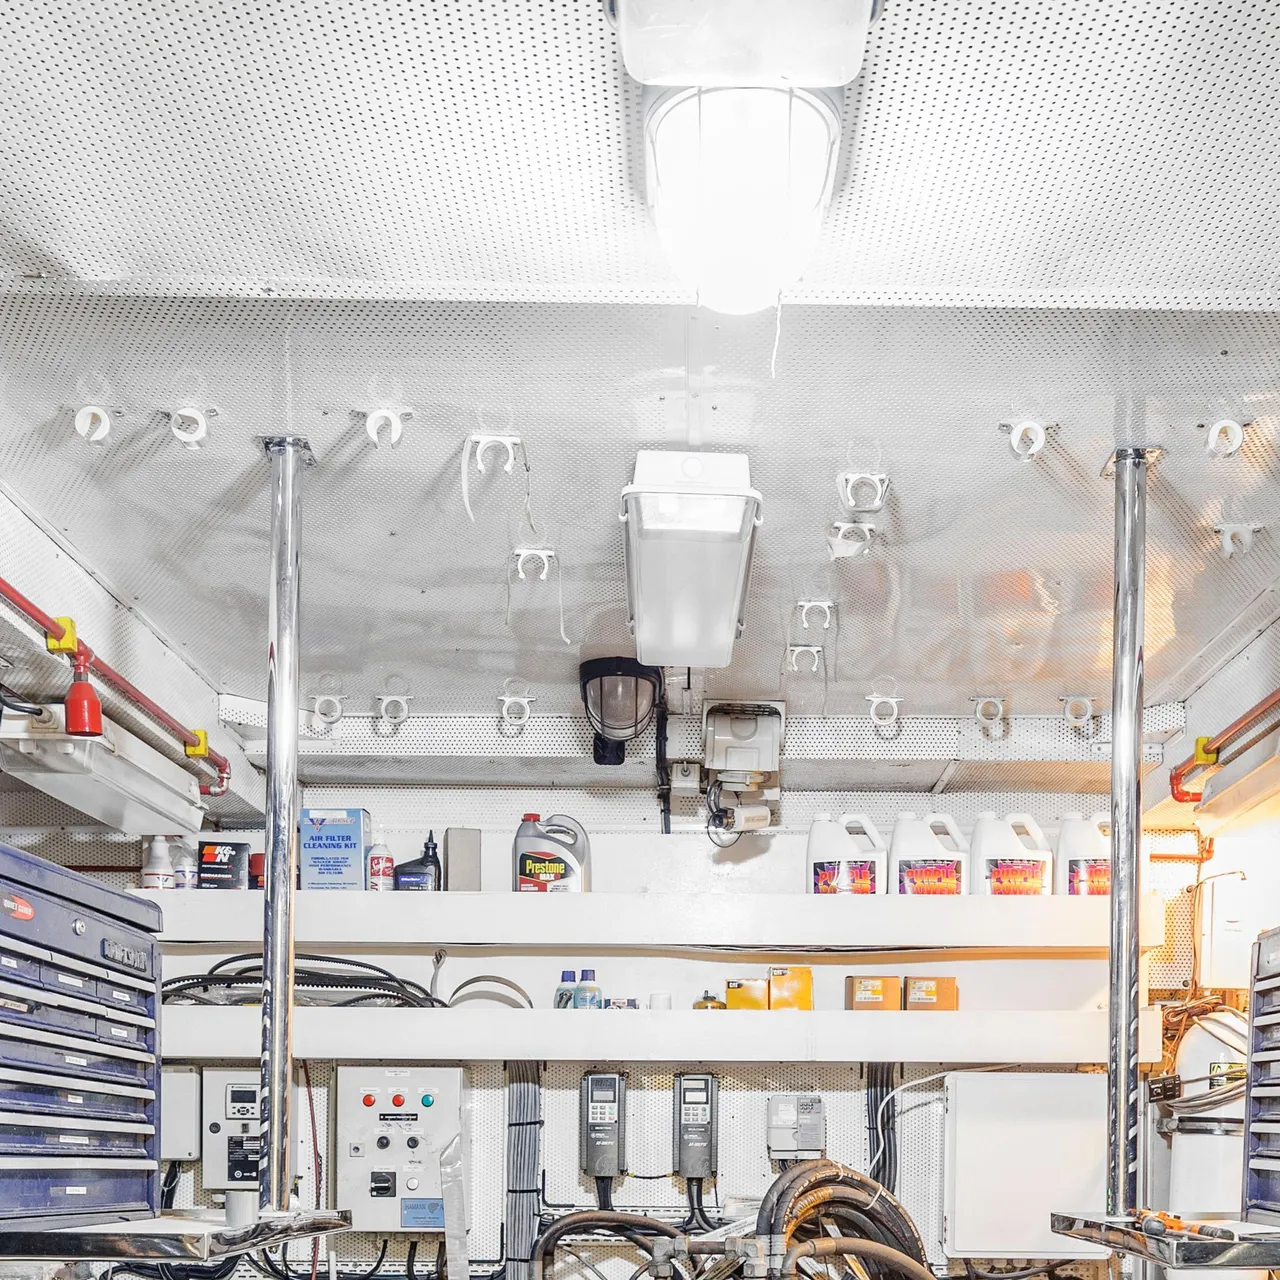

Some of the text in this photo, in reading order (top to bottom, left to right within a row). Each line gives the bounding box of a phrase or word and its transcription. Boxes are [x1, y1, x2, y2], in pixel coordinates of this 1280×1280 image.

[525, 860, 565, 874] Prestone
[906, 869, 956, 883] PURPLE
[992, 868, 1041, 881] PURPLE
